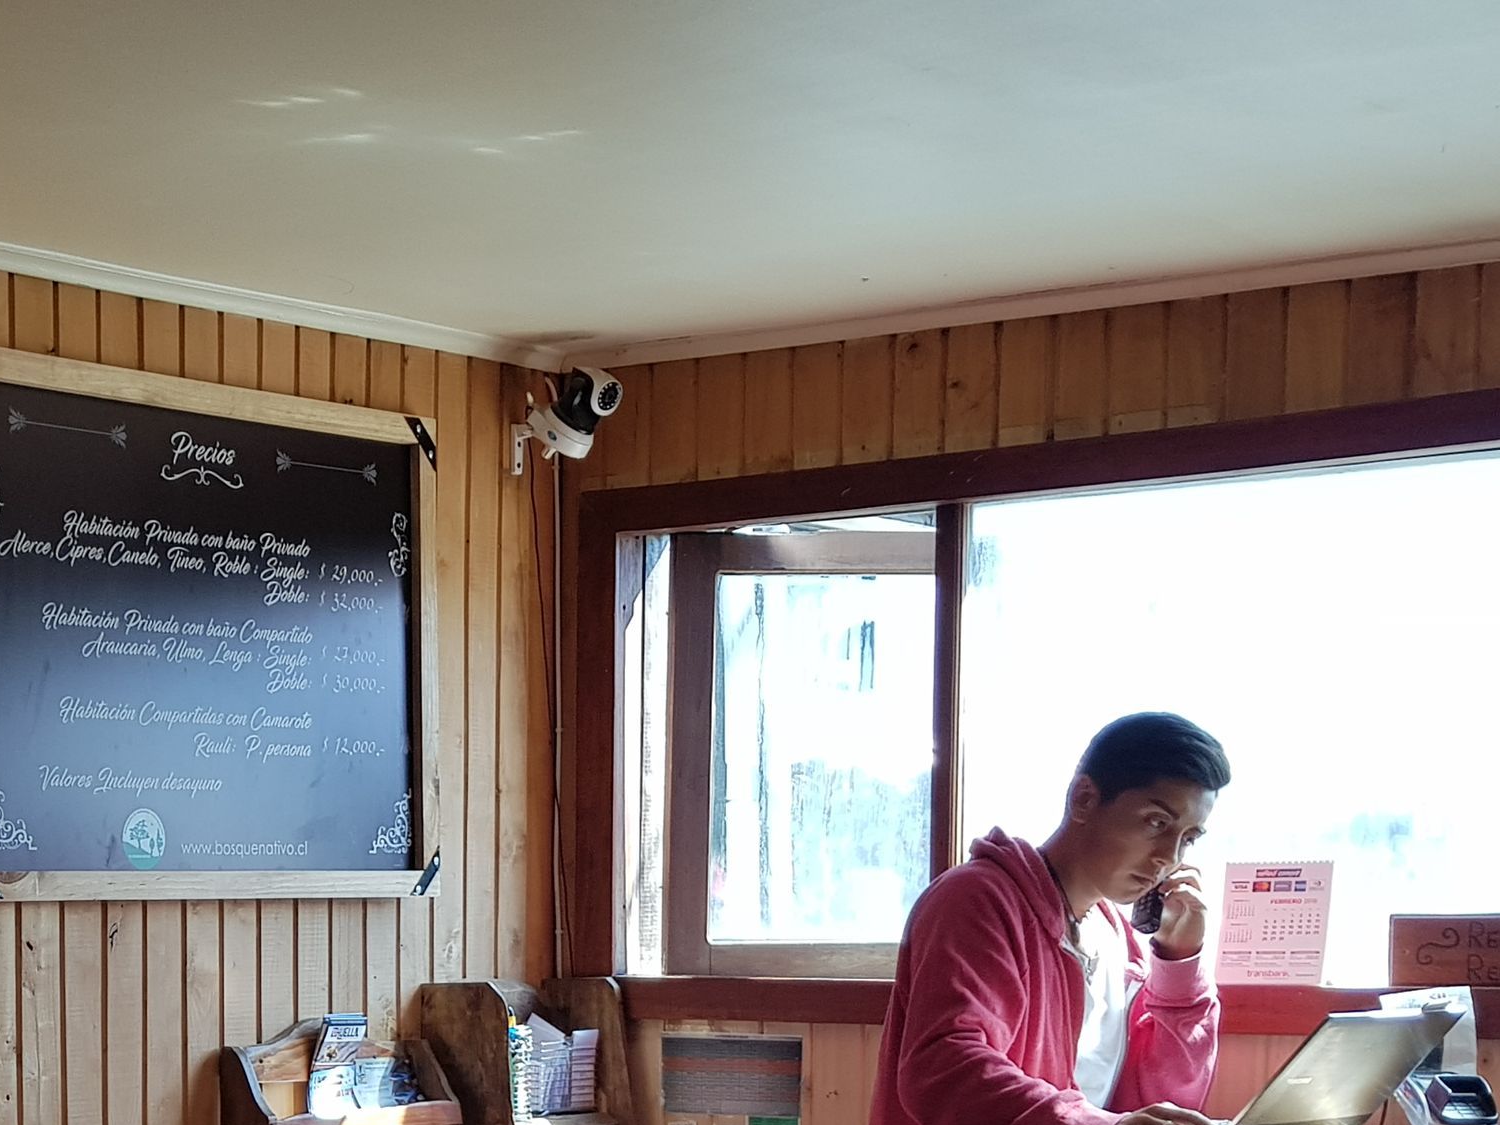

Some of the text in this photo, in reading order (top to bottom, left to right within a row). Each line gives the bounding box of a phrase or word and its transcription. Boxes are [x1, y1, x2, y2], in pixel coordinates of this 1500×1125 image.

[170, 431, 236, 466] Precios
[63, 510, 311, 558] Habitación Privada con baño Privado
[260, 557, 310, 588] Single:
[263, 581, 310, 606] Doble:
[41, 602, 314, 649] Habitación Privada con baño Compartido
[82, 631, 161, 660] Araucaria,
[162, 637, 207, 664] Ulmo,
[262, 645, 312, 675] Single:
[266, 668, 312, 694] Doble:
[59, 695, 313, 731] Habitación Compartidas con Camarote
[38, 764, 223, 799] Valores Incluyen desayuno
[181, 840, 308, 858] www.bosquenativo.cl
